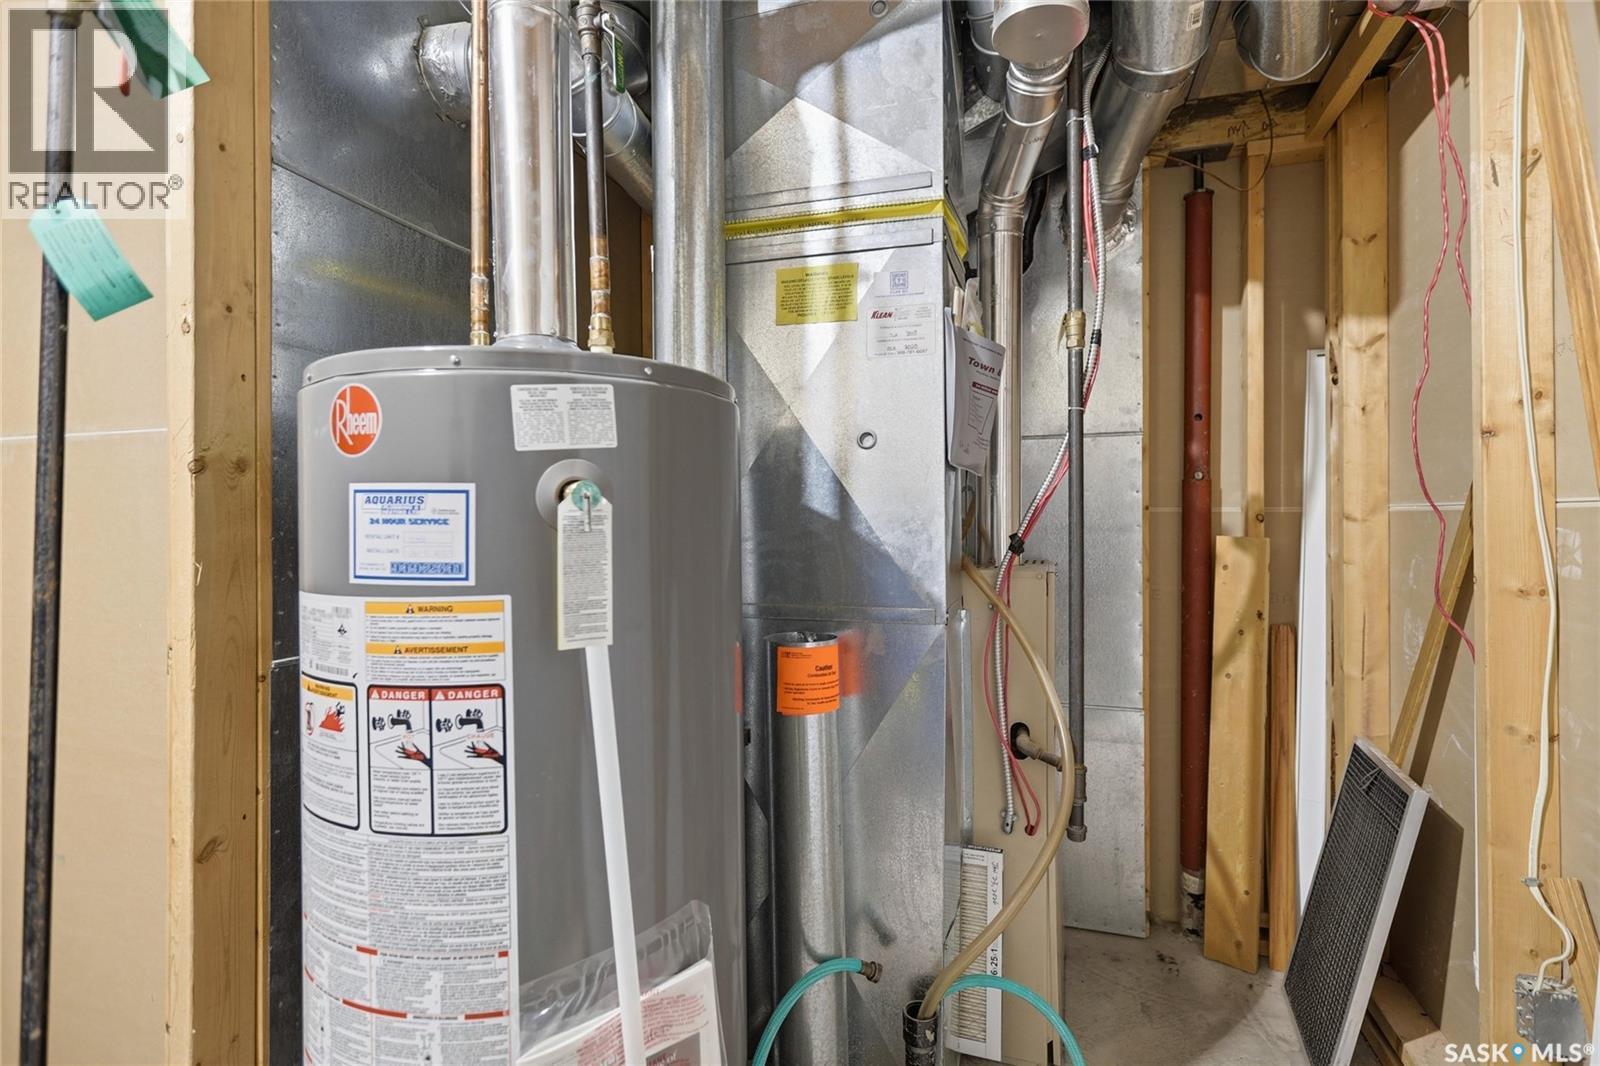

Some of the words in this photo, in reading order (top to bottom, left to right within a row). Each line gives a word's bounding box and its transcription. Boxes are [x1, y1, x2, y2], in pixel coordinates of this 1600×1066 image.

[967, 356, 996, 374] Town
[336, 387, 378, 446] Rheem
[364, 495, 425, 505] AQUARIUS
[408, 518, 450, 526] SERVICE
[417, 604, 453, 613] WARNING
[404, 646, 469, 654] AVERTISSEMENT
[381, 690, 426, 700] DANGER
[447, 689, 499, 700] DANGER
